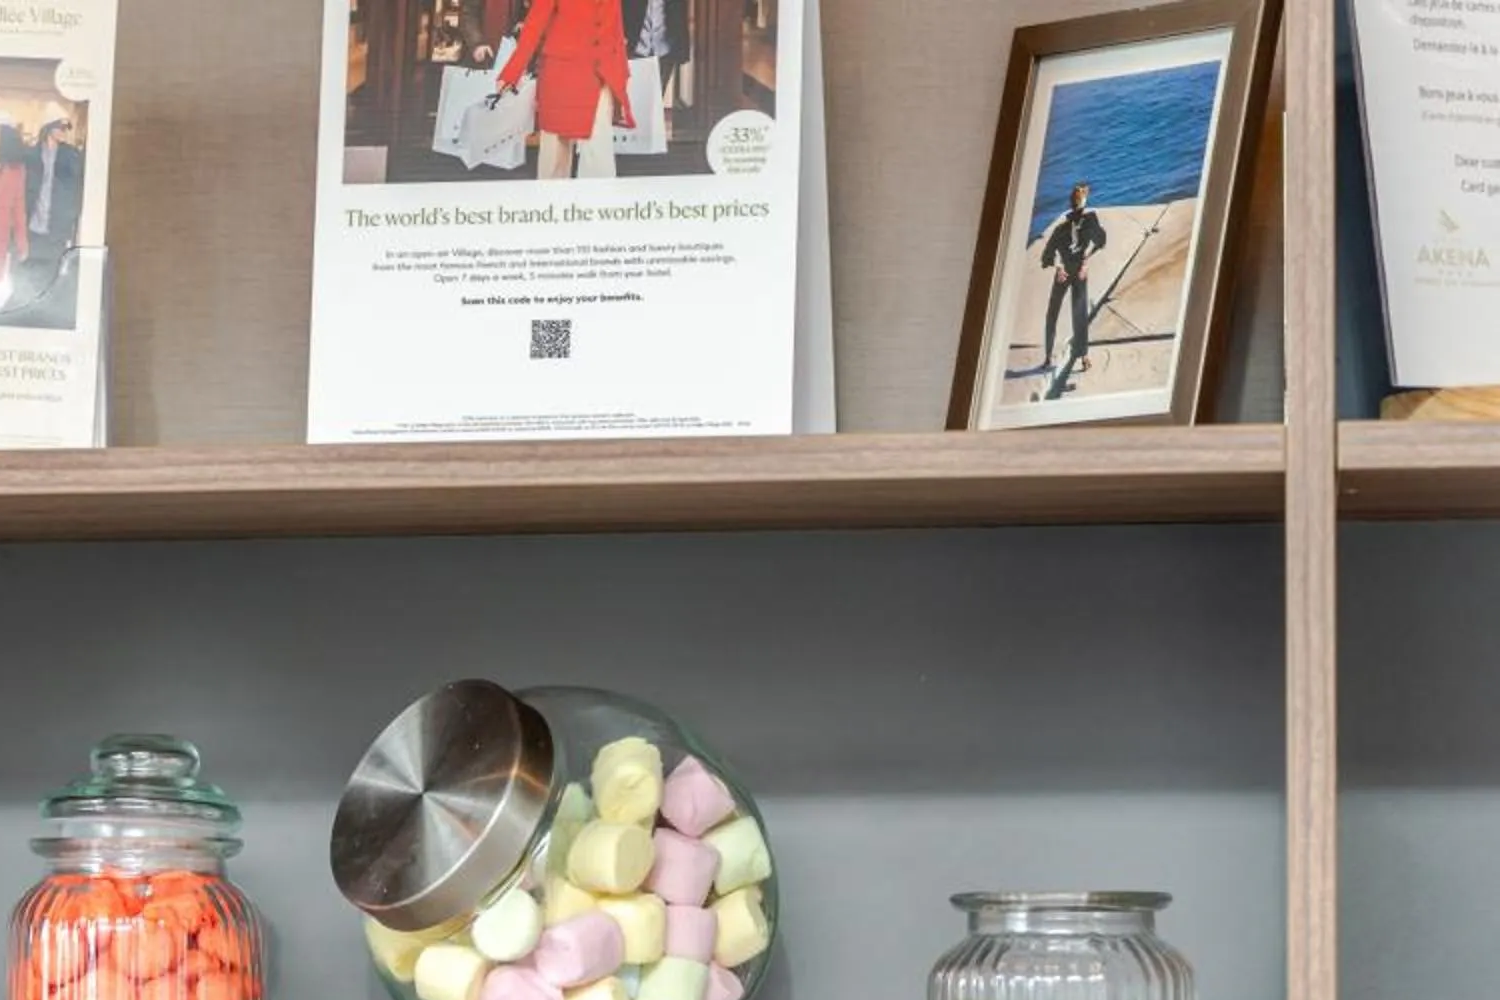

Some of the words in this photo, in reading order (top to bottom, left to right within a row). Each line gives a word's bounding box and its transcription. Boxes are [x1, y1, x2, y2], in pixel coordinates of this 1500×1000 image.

[344, 208, 380, 228] The
[385, 207, 451, 225] world's
[455, 206, 494, 225] best
[499, 203, 559, 225] brand,
[563, 203, 594, 222] the
[597, 200, 664, 221] world's
[668, 201, 708, 220] best
[711, 199, 770, 222] prices
